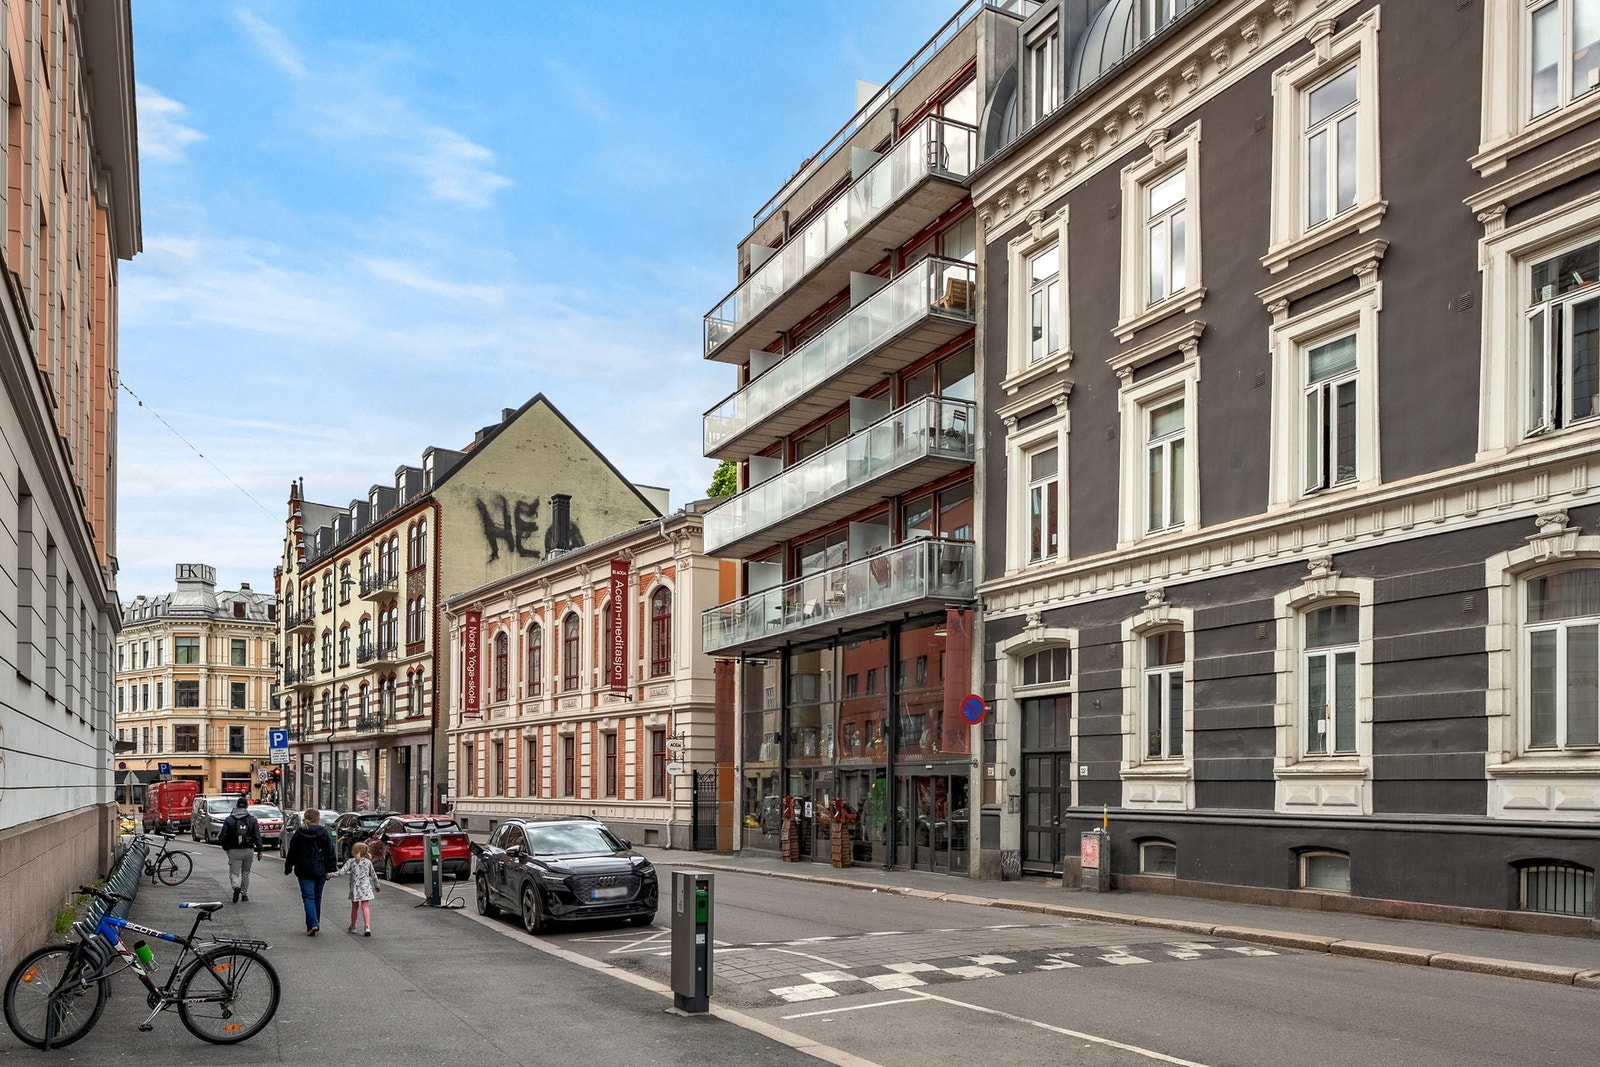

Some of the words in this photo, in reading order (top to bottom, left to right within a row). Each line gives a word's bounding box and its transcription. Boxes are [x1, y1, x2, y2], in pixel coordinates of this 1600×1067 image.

[468, 626, 477, 653] Norsk
[612, 579, 625, 680] Acem-meditasjon
[467, 655, 477, 704] Yoga-skole
[273, 732, 284, 747] P
[160, 763, 167, 773] P
[125, 922, 166, 937] SCOTT
